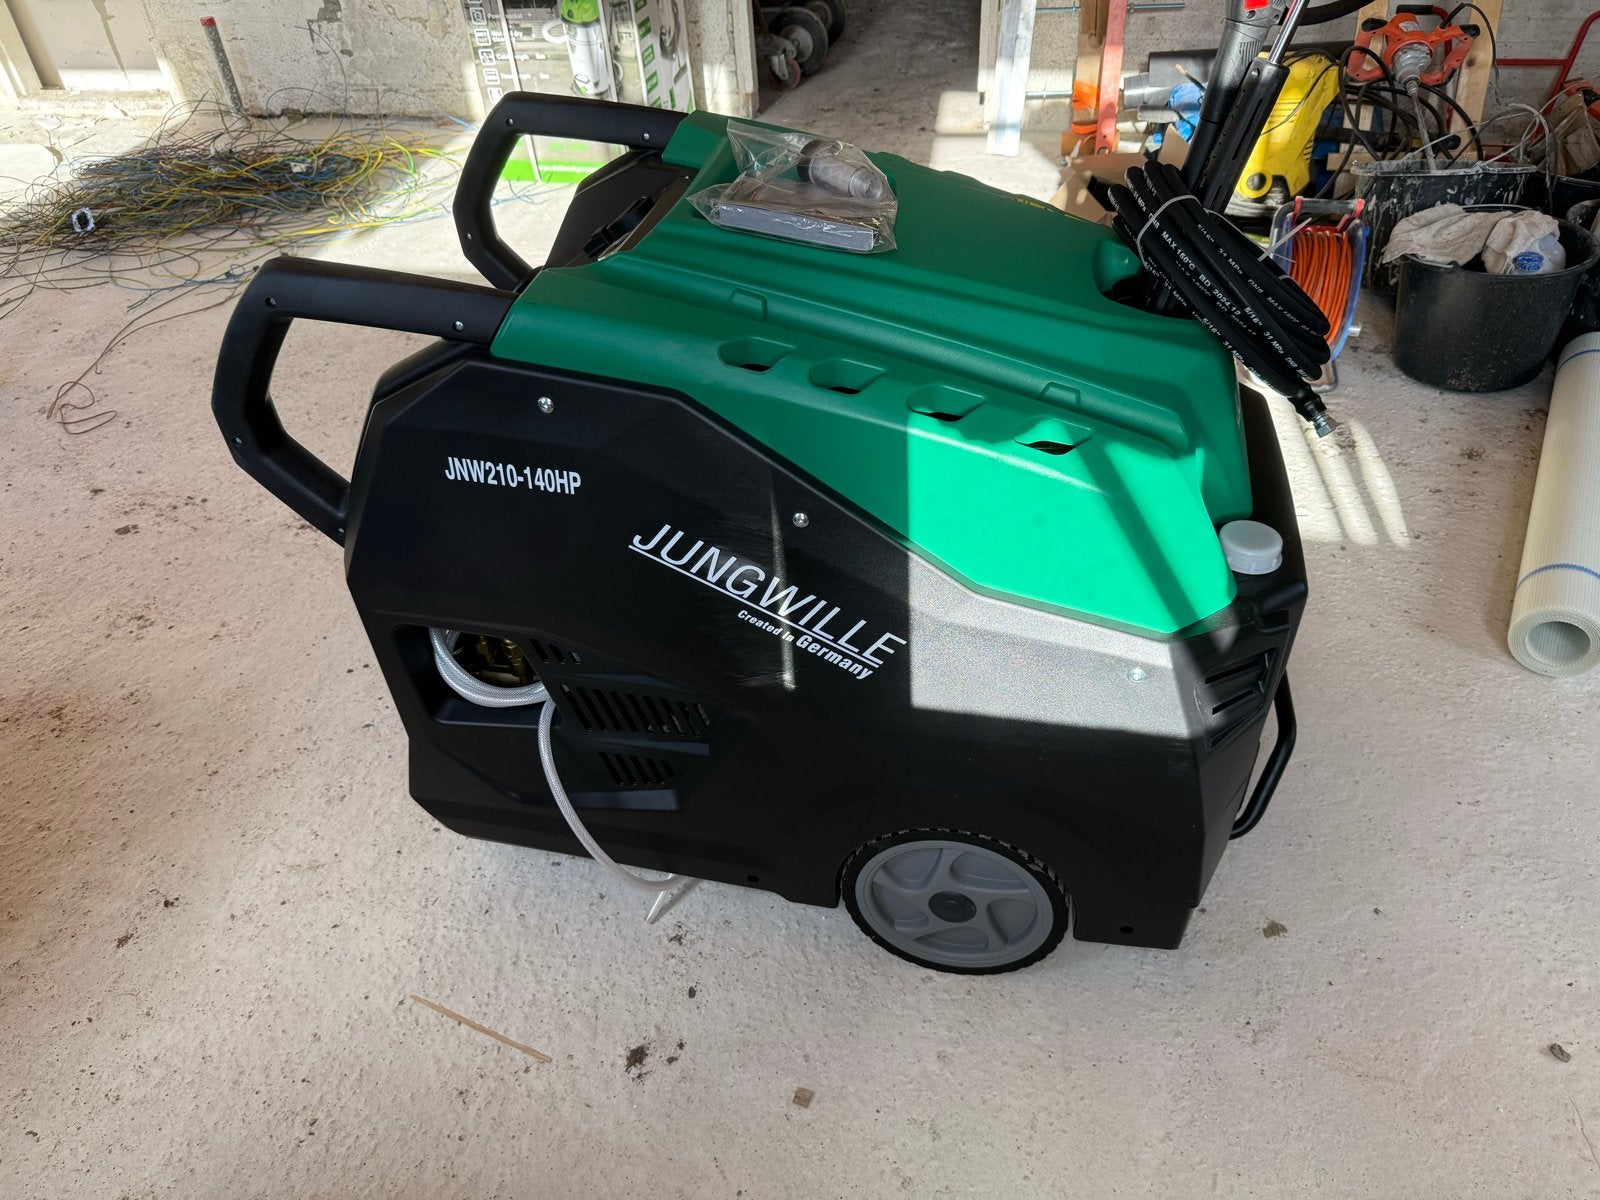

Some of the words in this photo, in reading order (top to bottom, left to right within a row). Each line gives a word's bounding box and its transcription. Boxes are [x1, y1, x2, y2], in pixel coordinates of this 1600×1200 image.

[1161, 230, 1178, 250] MAX
[1198, 273, 1211, 287] BD
[1212, 288, 1241, 316] 2024.12
[1227, 257, 1243, 275] MPa
[1263, 330, 1274, 340] 31
[445, 457, 582, 495] JNW210-140HP
[632, 524, 907, 666] JUNGWILLE
[737, 609, 783, 636] Created
[795, 634, 873, 680] Germany
